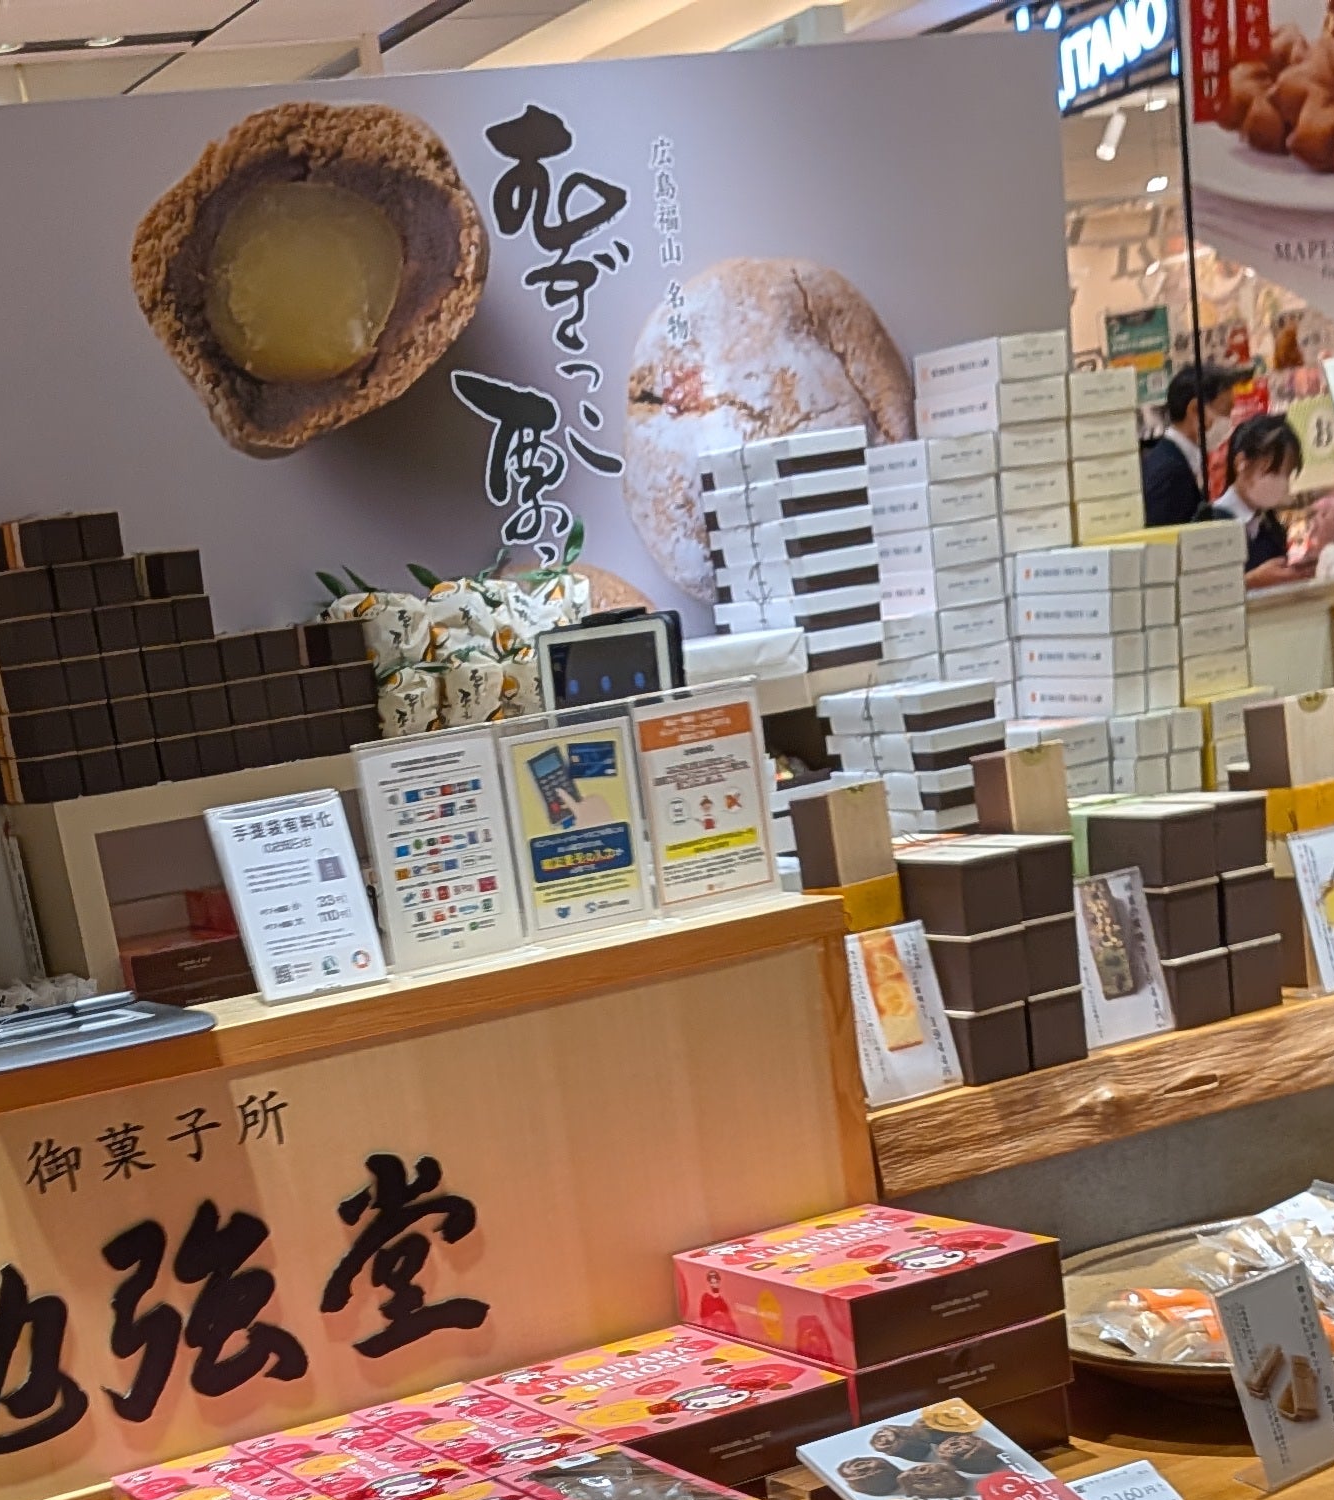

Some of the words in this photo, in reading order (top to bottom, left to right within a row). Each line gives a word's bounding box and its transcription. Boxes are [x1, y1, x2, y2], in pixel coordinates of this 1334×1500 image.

[25, 1090, 291, 1195] 御菓子所
[750, 1217, 895, 1261] FUKUYAMA
[543, 1345, 697, 1392] FUKUYAMA
[619, 1354, 701, 1381] ROSE
